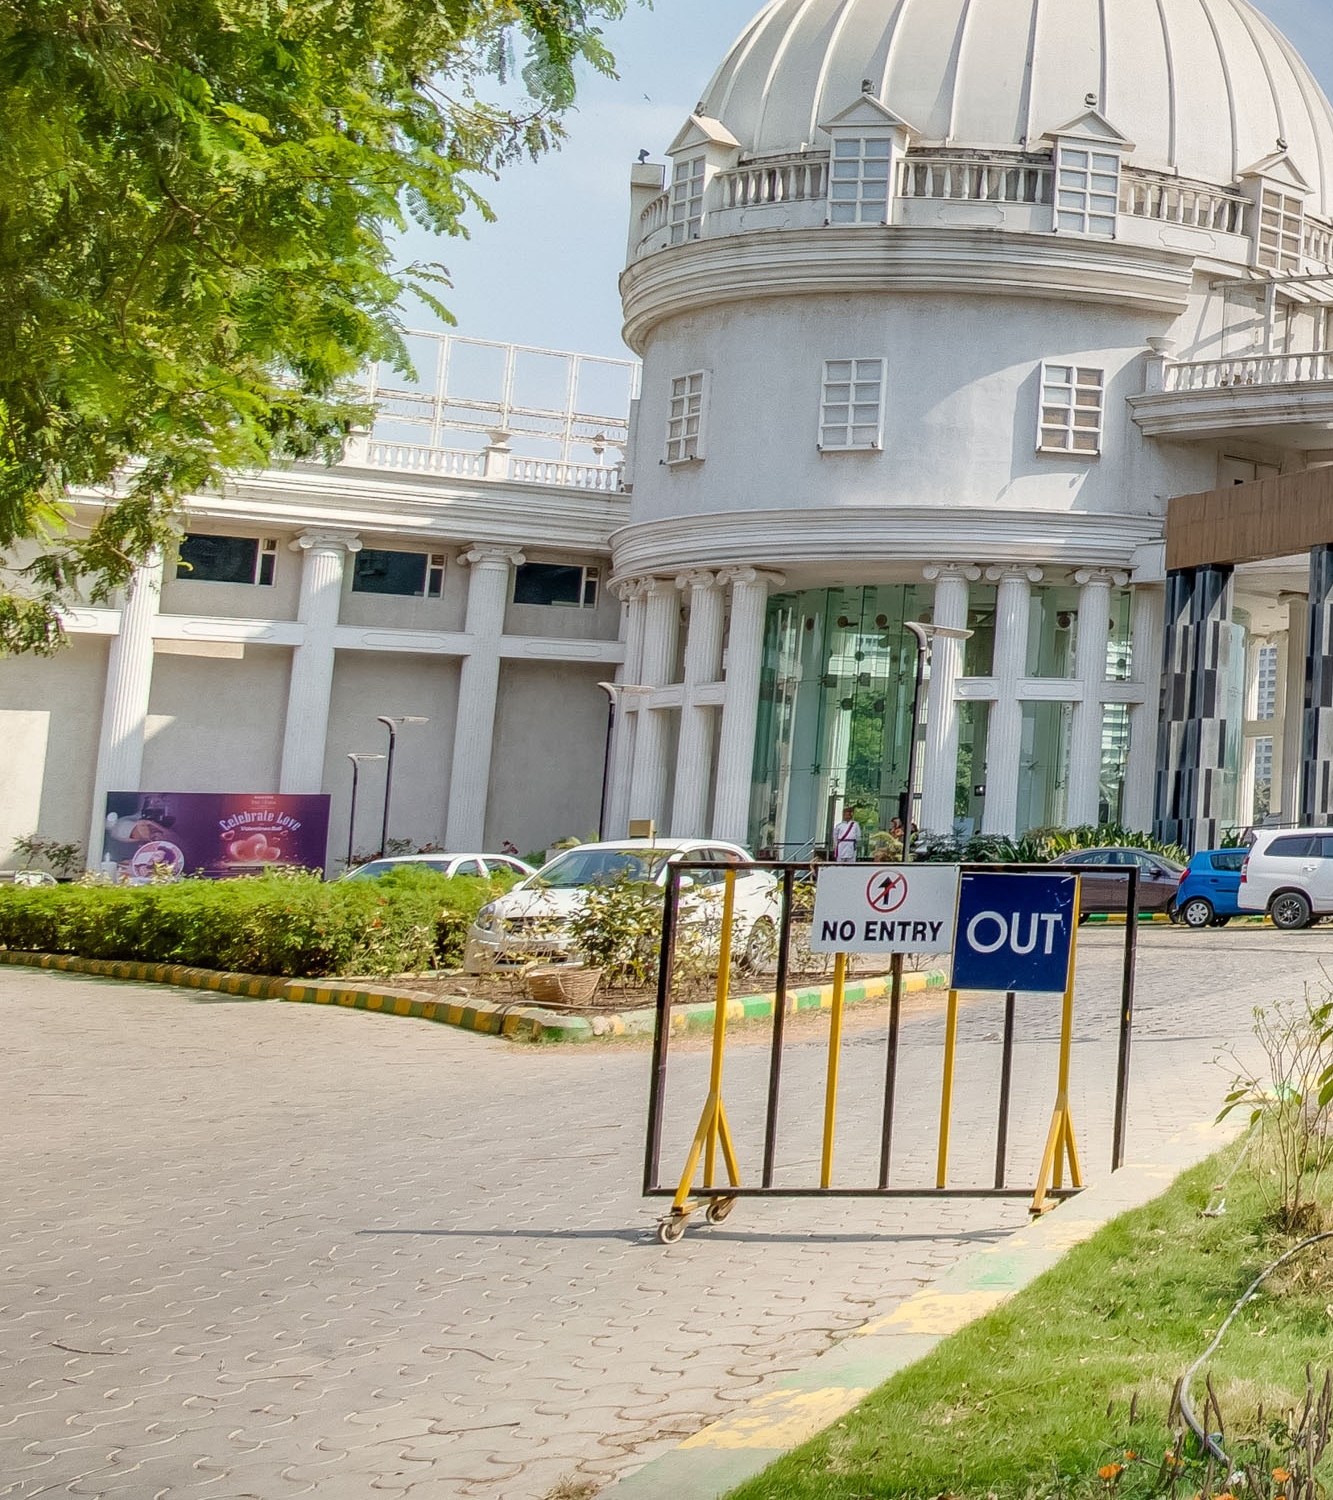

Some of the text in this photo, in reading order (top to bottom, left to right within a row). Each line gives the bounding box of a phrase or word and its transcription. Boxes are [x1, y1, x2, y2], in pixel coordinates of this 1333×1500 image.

[219, 810, 302, 831] Celebrate Love
[821, 920, 943, 942] NO ENTRY
[967, 911, 1062, 955] OUT
